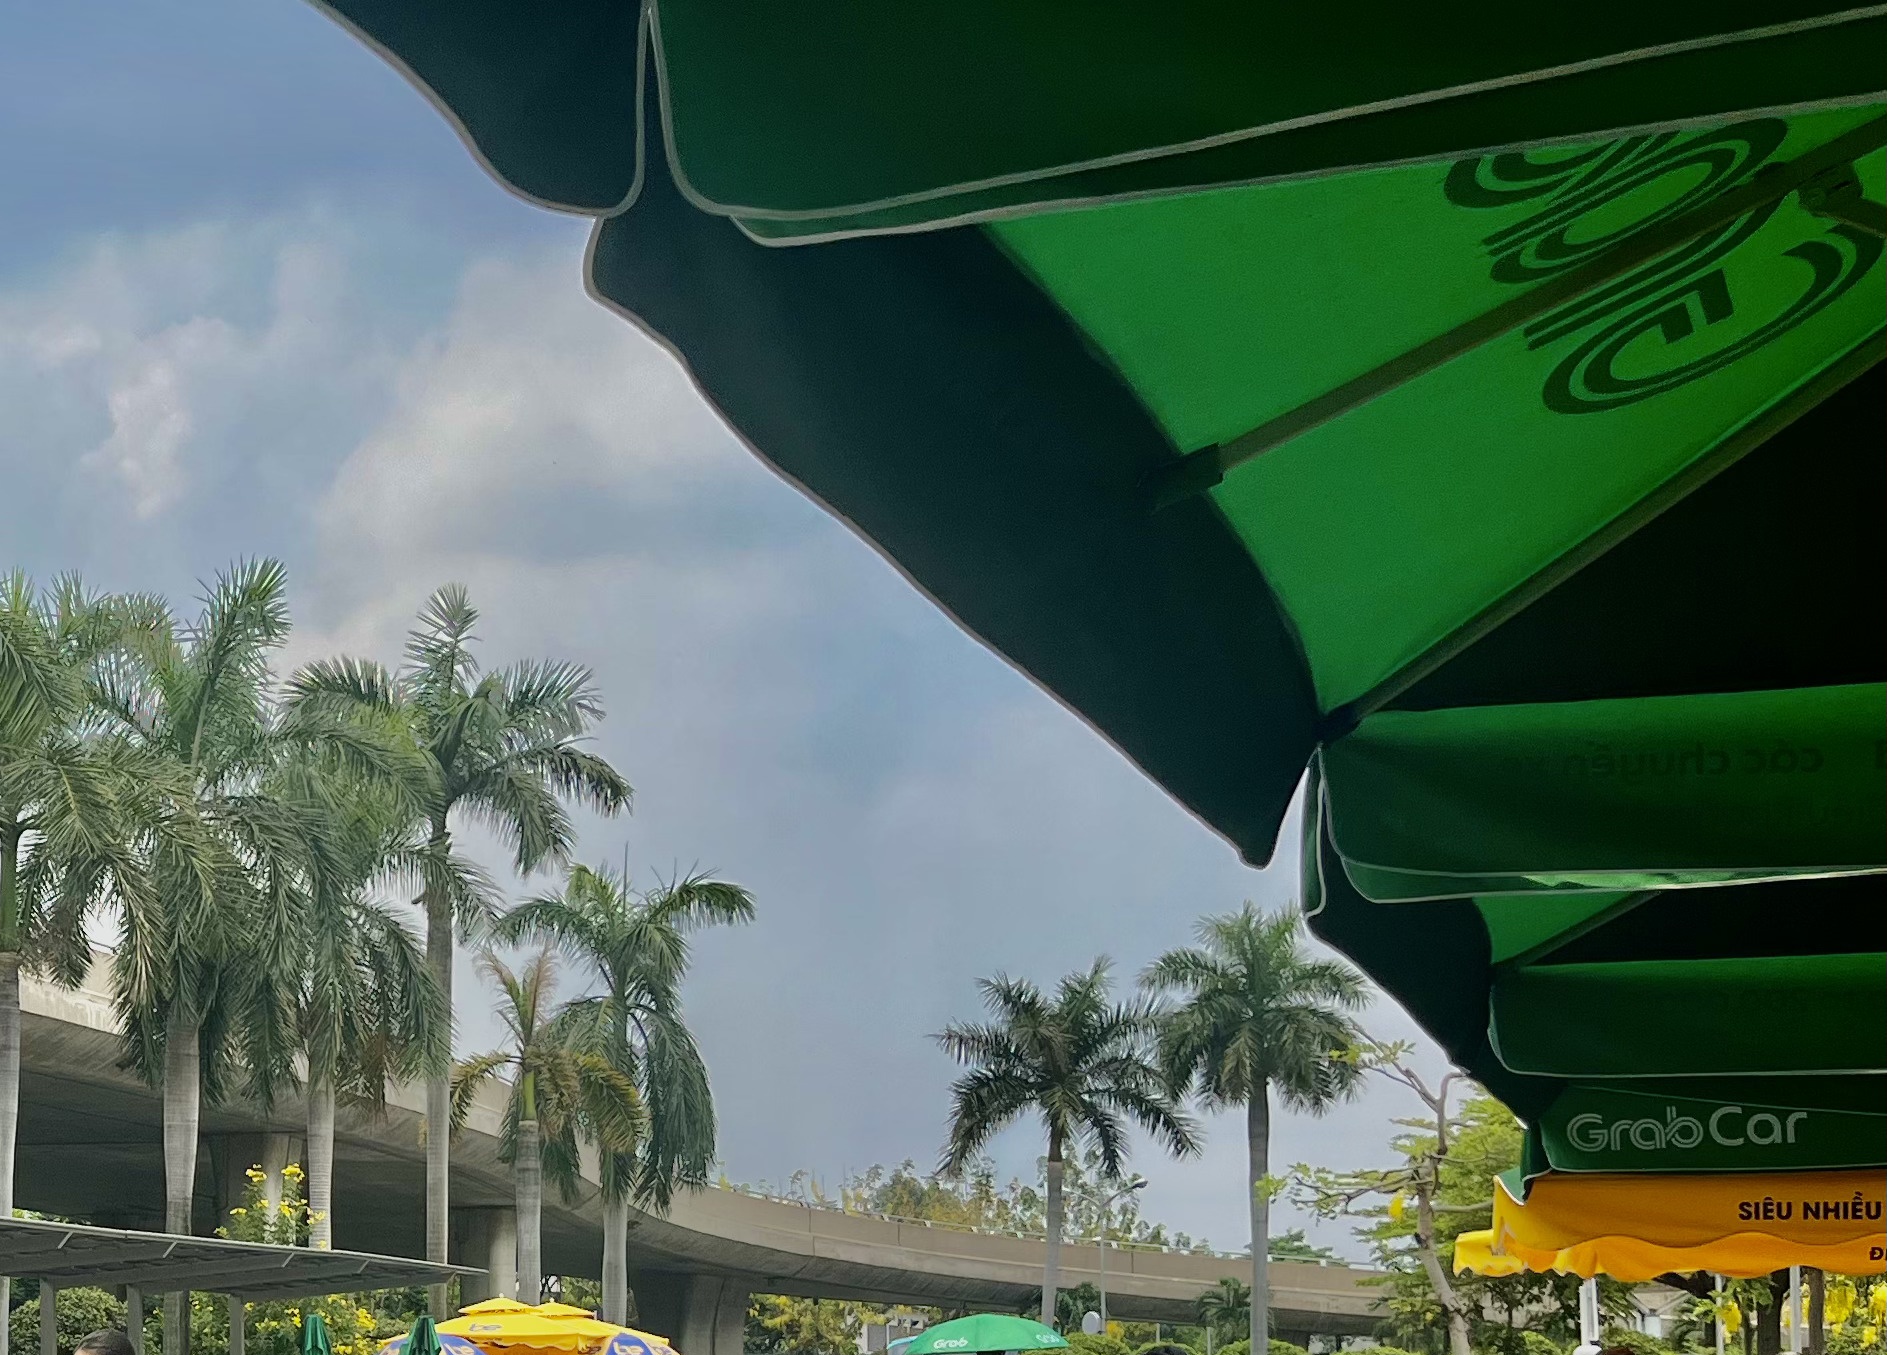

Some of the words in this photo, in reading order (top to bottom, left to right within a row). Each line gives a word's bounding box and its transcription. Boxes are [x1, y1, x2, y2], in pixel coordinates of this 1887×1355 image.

[1738, 1196, 1793, 1221] SIÊU
[1802, 1191, 1882, 1221] NHIỀU
[613, 1341, 644, 1355] be
[933, 1336, 969, 1349] Grab
